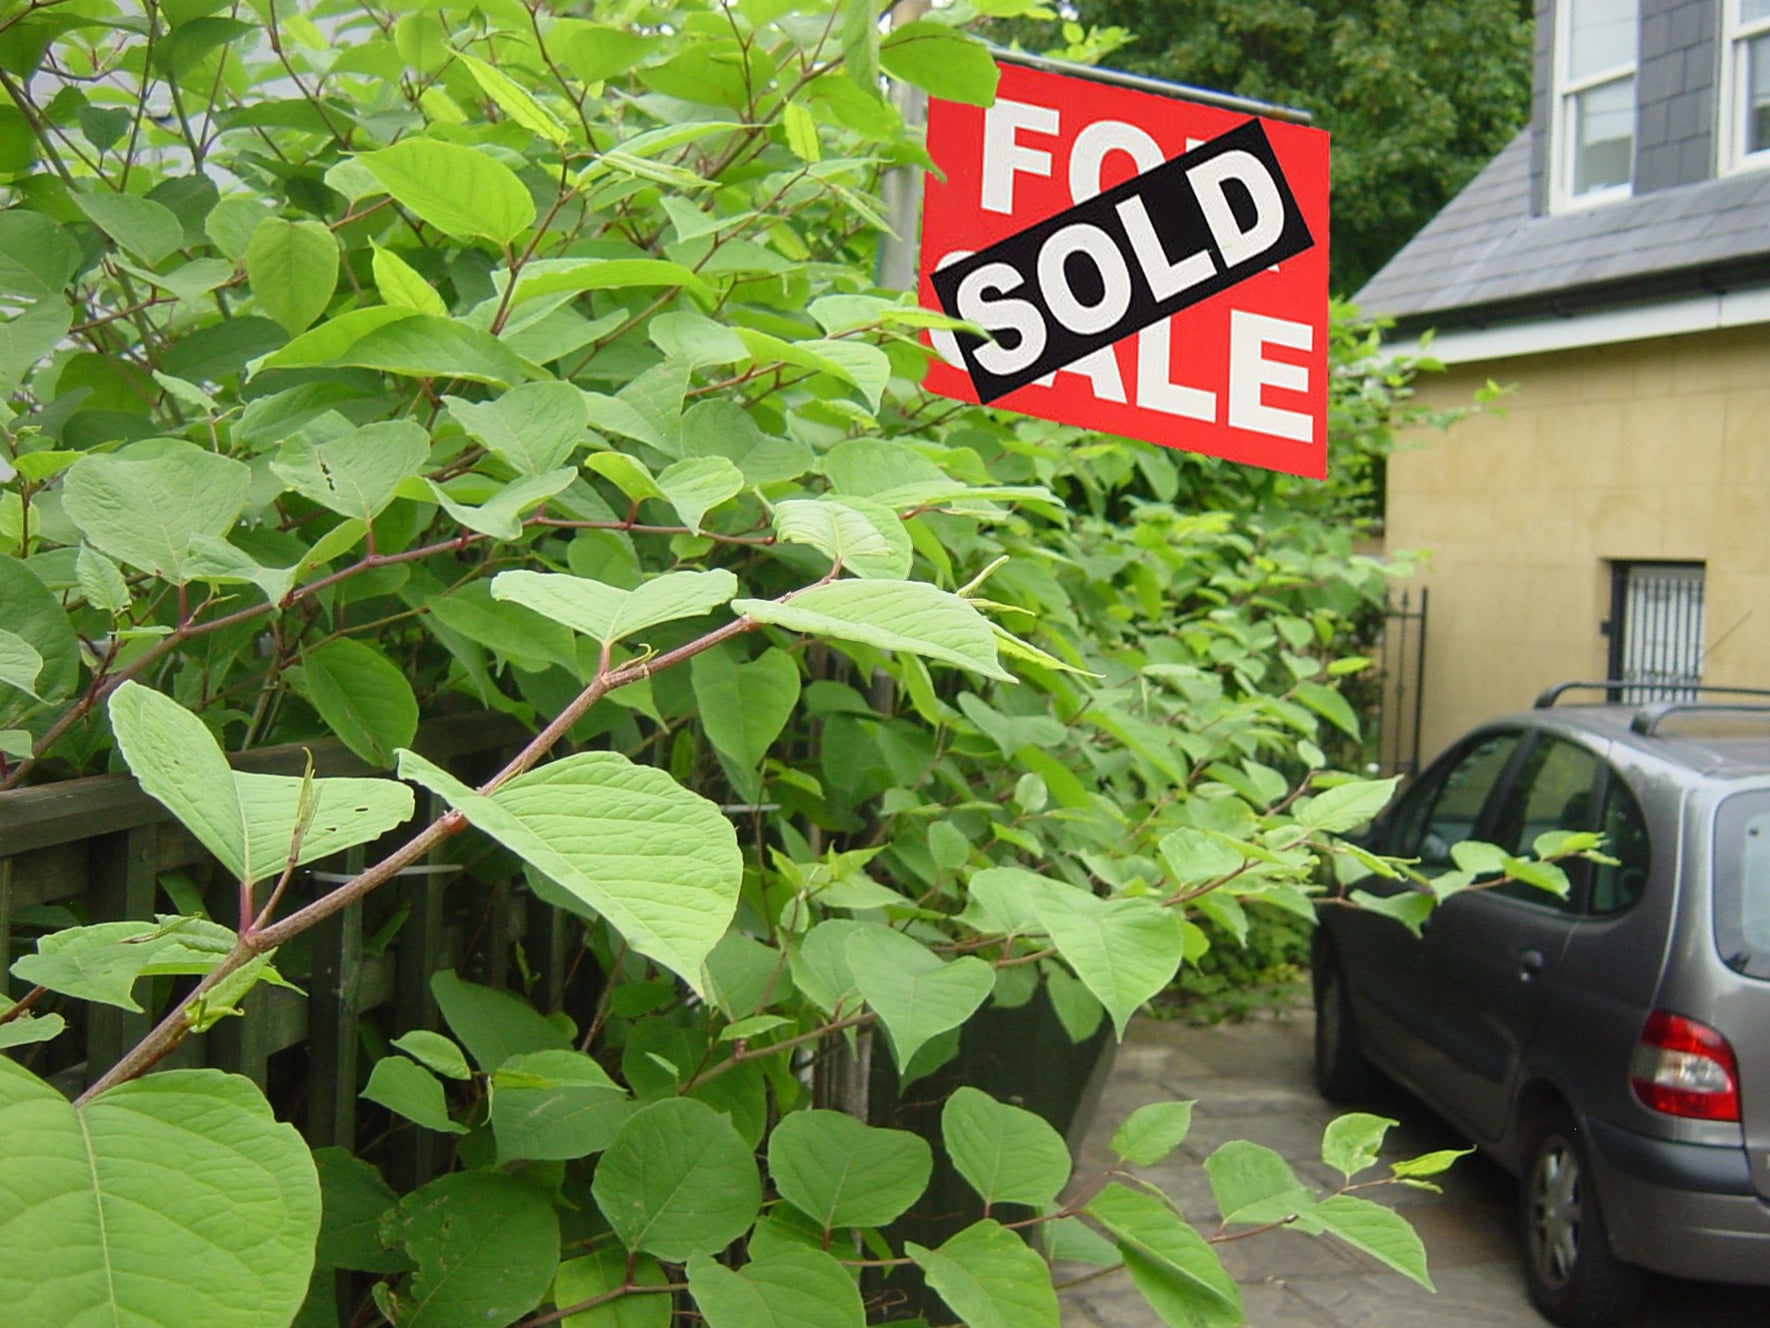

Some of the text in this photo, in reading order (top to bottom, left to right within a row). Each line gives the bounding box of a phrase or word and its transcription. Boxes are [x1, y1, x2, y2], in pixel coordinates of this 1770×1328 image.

[957, 150, 1285, 376] SOLD
[981, 98, 1280, 272] FO
[929, 251, 1314, 444] LE
